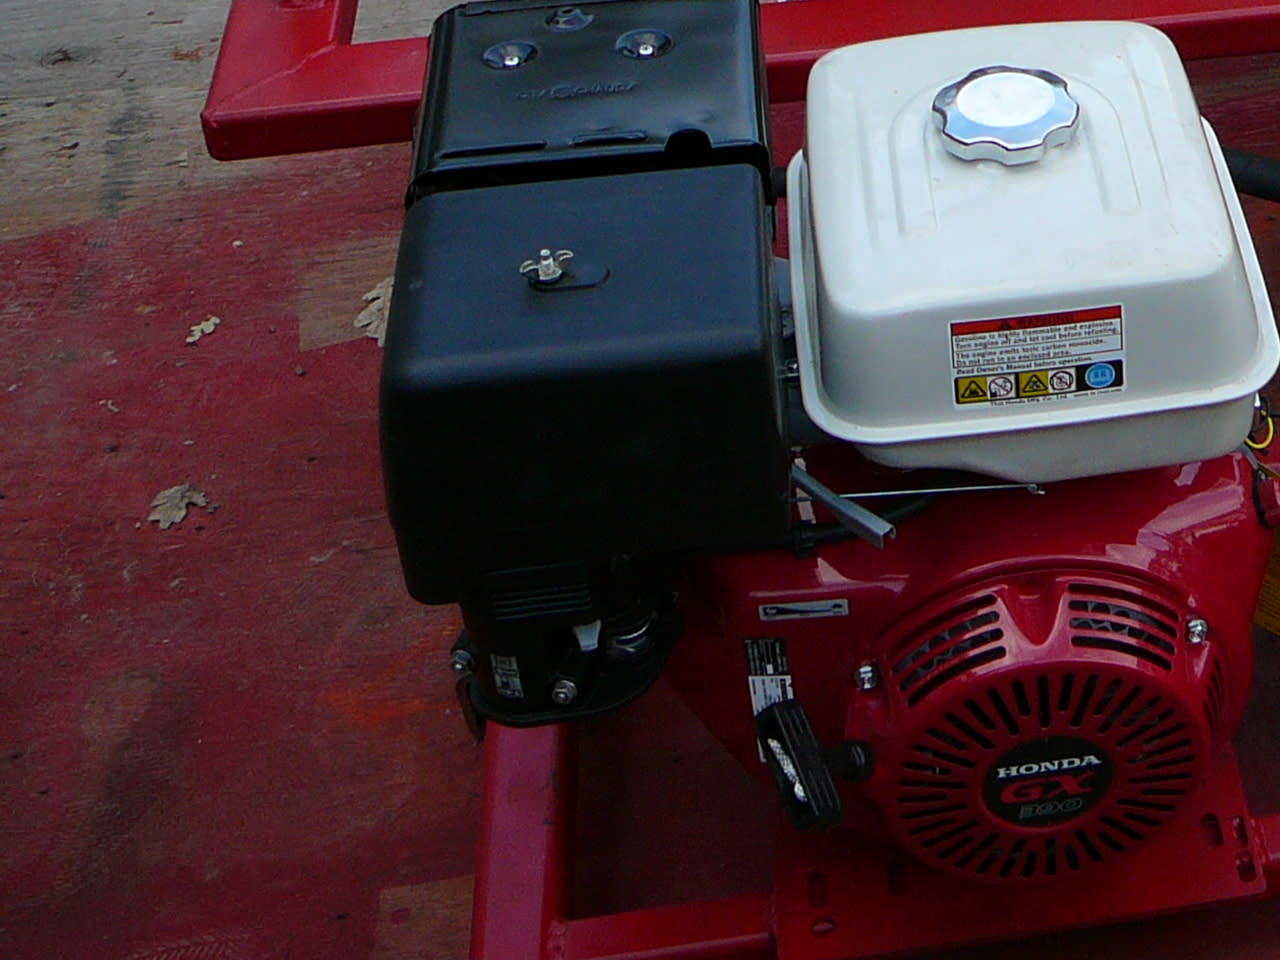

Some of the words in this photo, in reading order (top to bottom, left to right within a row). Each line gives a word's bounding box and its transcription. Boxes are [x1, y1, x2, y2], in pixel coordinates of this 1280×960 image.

[1058, 329, 1083, 338] before
[997, 755, 1102, 778] HONDA
[1002, 770, 1095, 804] GX
